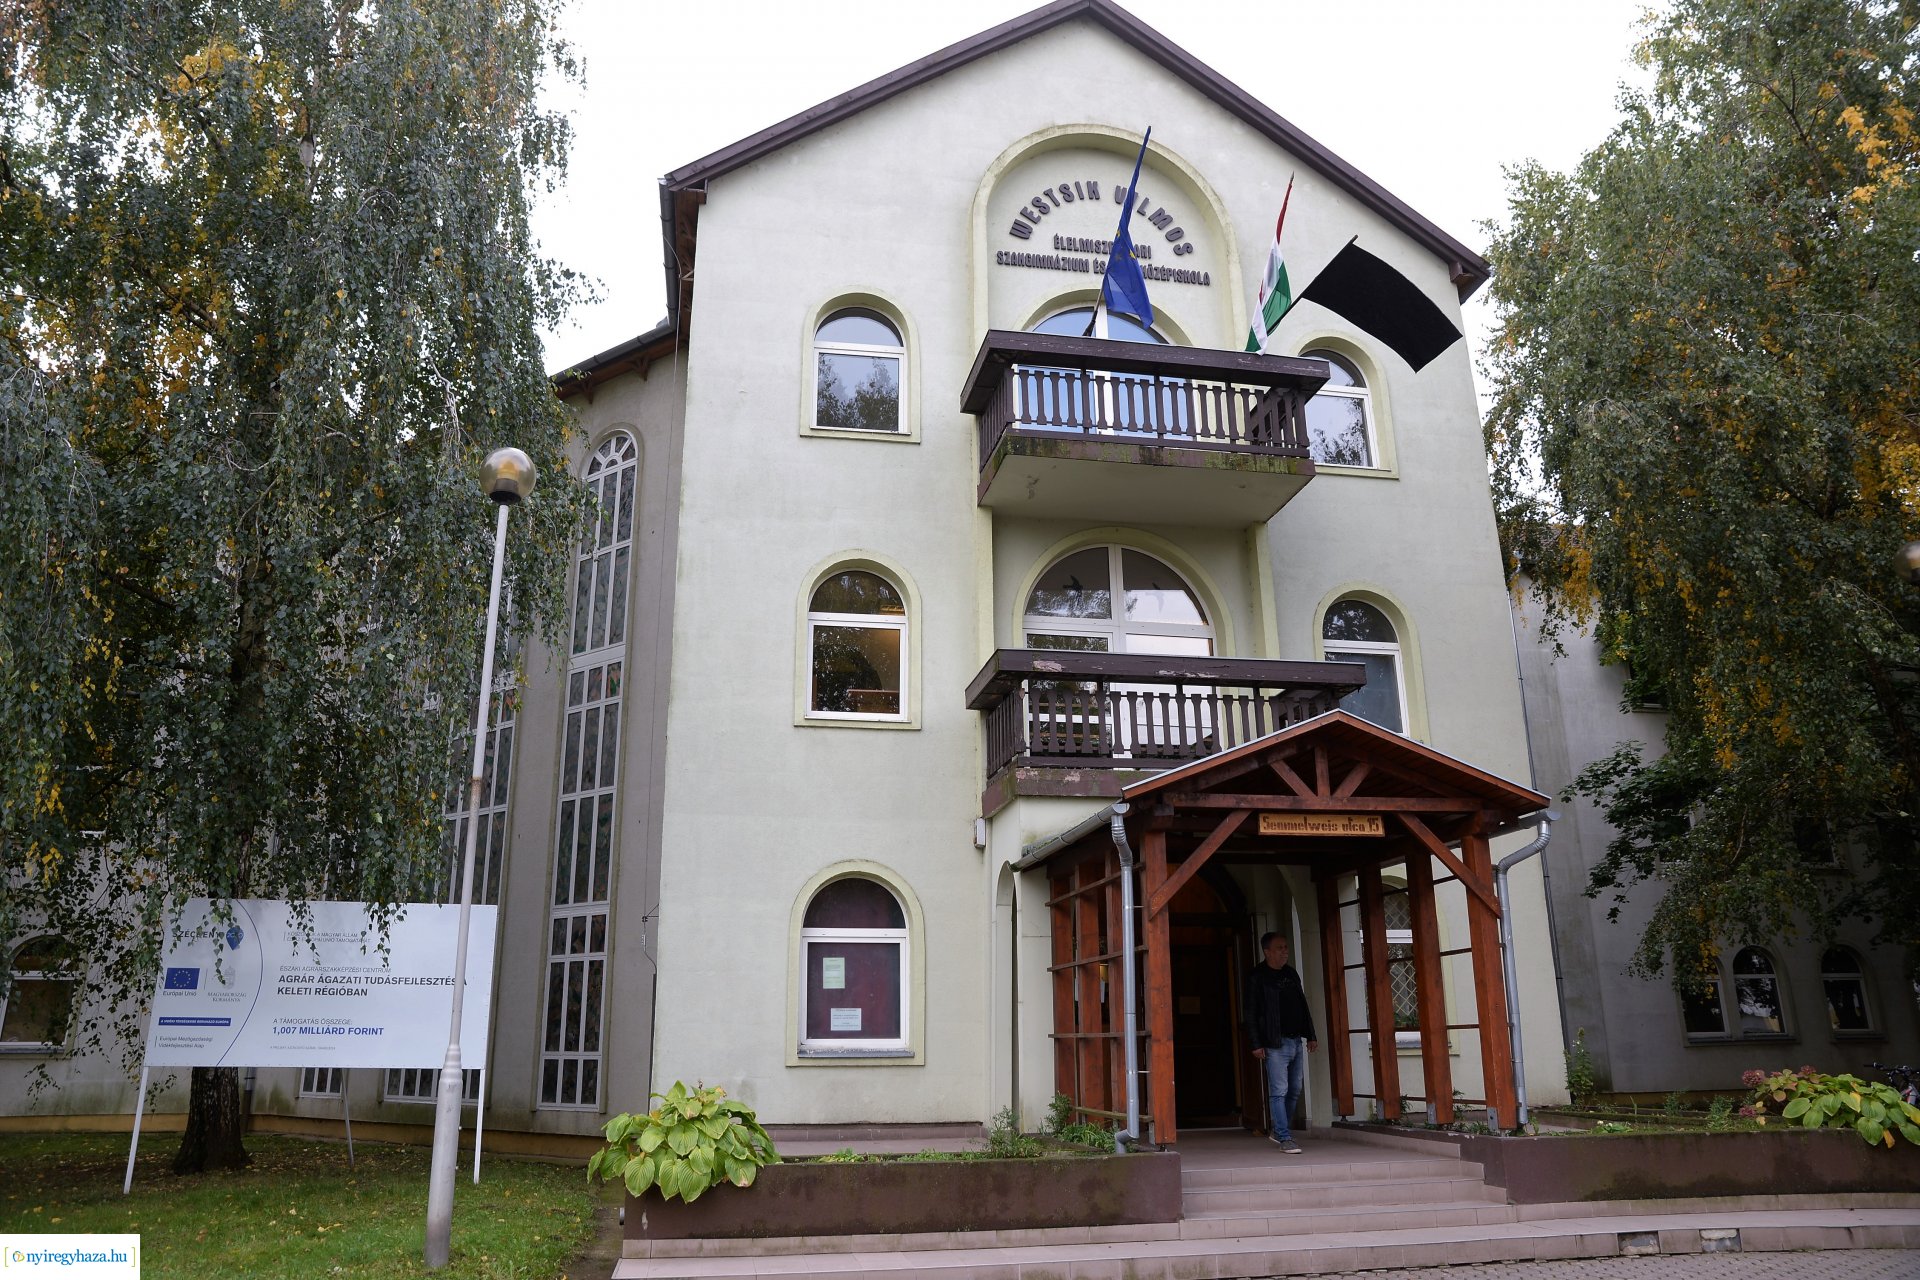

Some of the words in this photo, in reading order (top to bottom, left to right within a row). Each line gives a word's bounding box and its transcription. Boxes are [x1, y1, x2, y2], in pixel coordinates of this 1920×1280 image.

[1009, 181, 1100, 240] WESTSIK
[996, 250, 1090, 273] SZAKGIMNÁZIUM
[1092, 258, 1106, 275] ÉS
[1140, 264, 1211, 287] KÖZÉPISKOLA
[1262, 815, 1338, 832] Semmelweis
[1341, 817, 1366, 832] utca
[363, 966, 391, 974] CENTRUM
[278, 973, 315, 984] AGRÁR
[317, 973, 361, 985] ÁGAZATI
[277, 986, 312, 996] KELETI
[314, 985, 368, 996] RÉGIÓBAN
[279, 1017, 319, 1025] TÁMOGATÁS
[272, 1026, 297, 1035] 1,007
[299, 1024, 346, 1035] MILLIÁRD
[347, 1027, 384, 1036] FORINT
